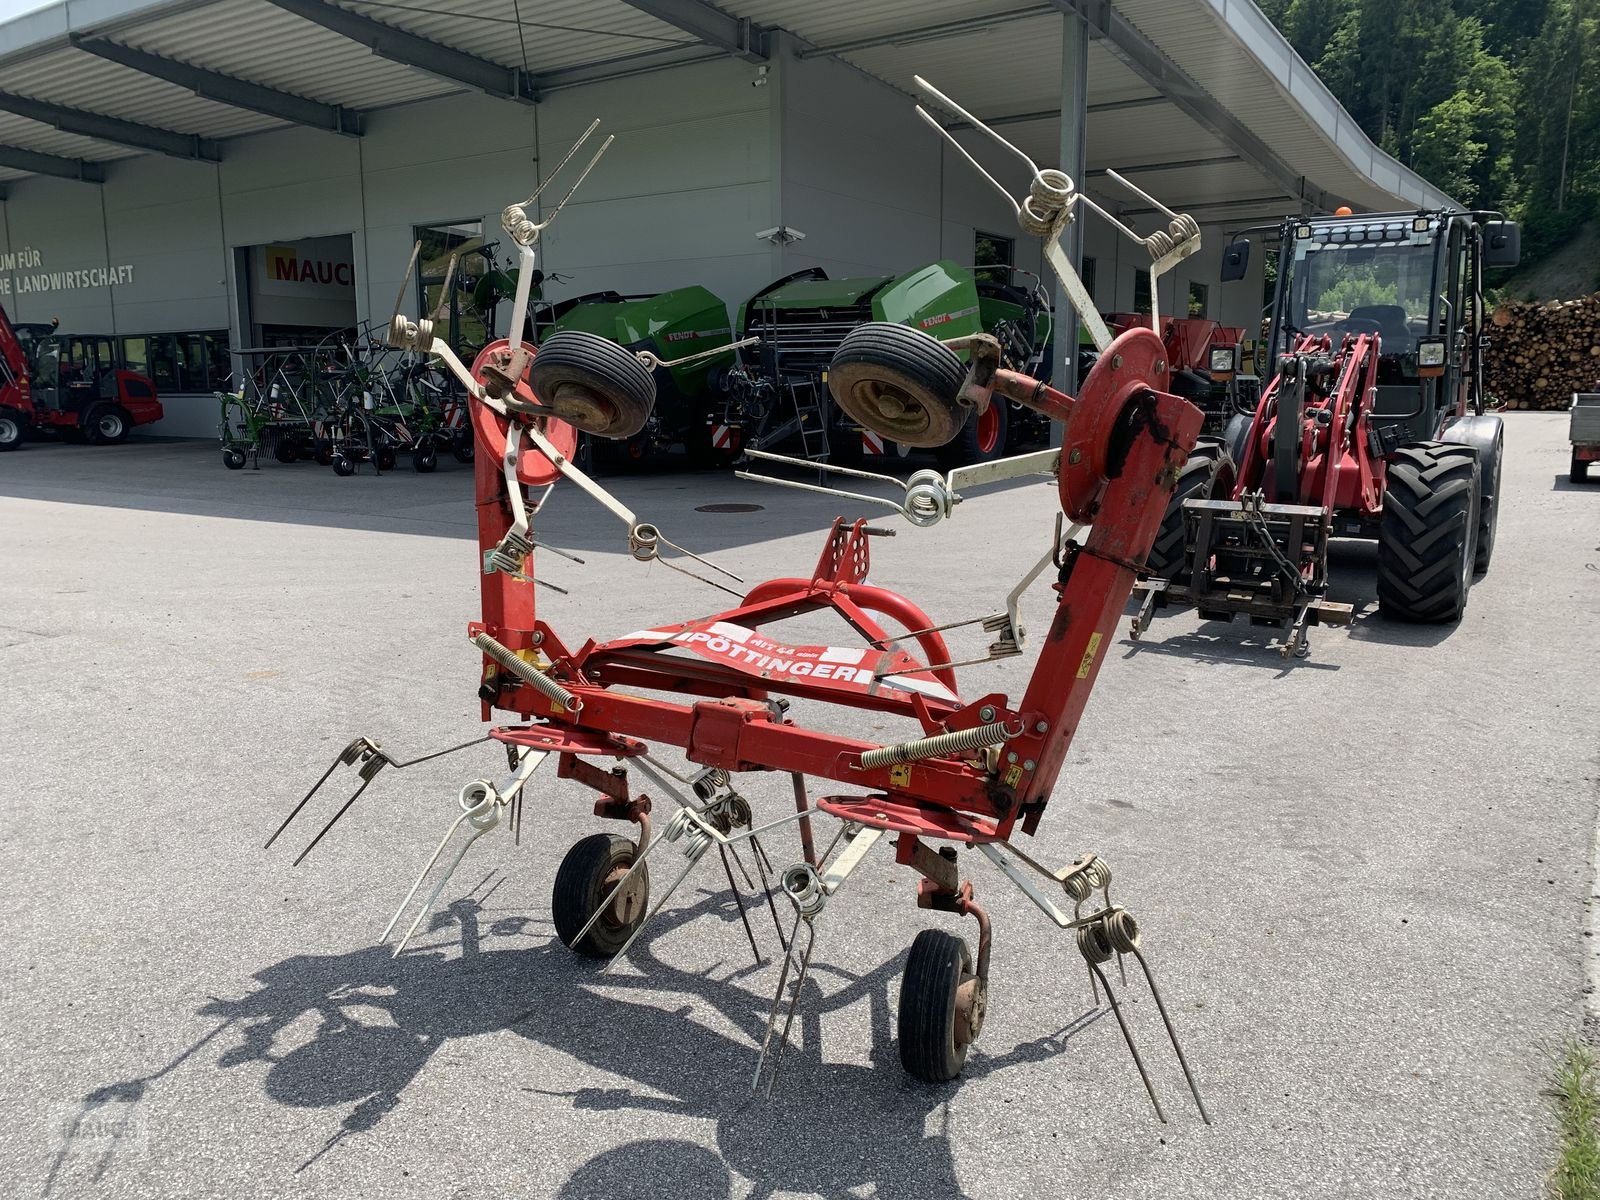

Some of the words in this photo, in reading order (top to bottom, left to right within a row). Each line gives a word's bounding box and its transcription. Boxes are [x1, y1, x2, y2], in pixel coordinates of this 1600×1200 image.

[18, 246, 41, 269] FÜR
[16, 265, 133, 293] LANDWIRTSCHAFT
[275, 256, 354, 286] MAUC
[923, 312, 947, 327] FENDT
[668, 330, 695, 341] FENDT
[688, 632, 857, 682] PÖTTINGER
